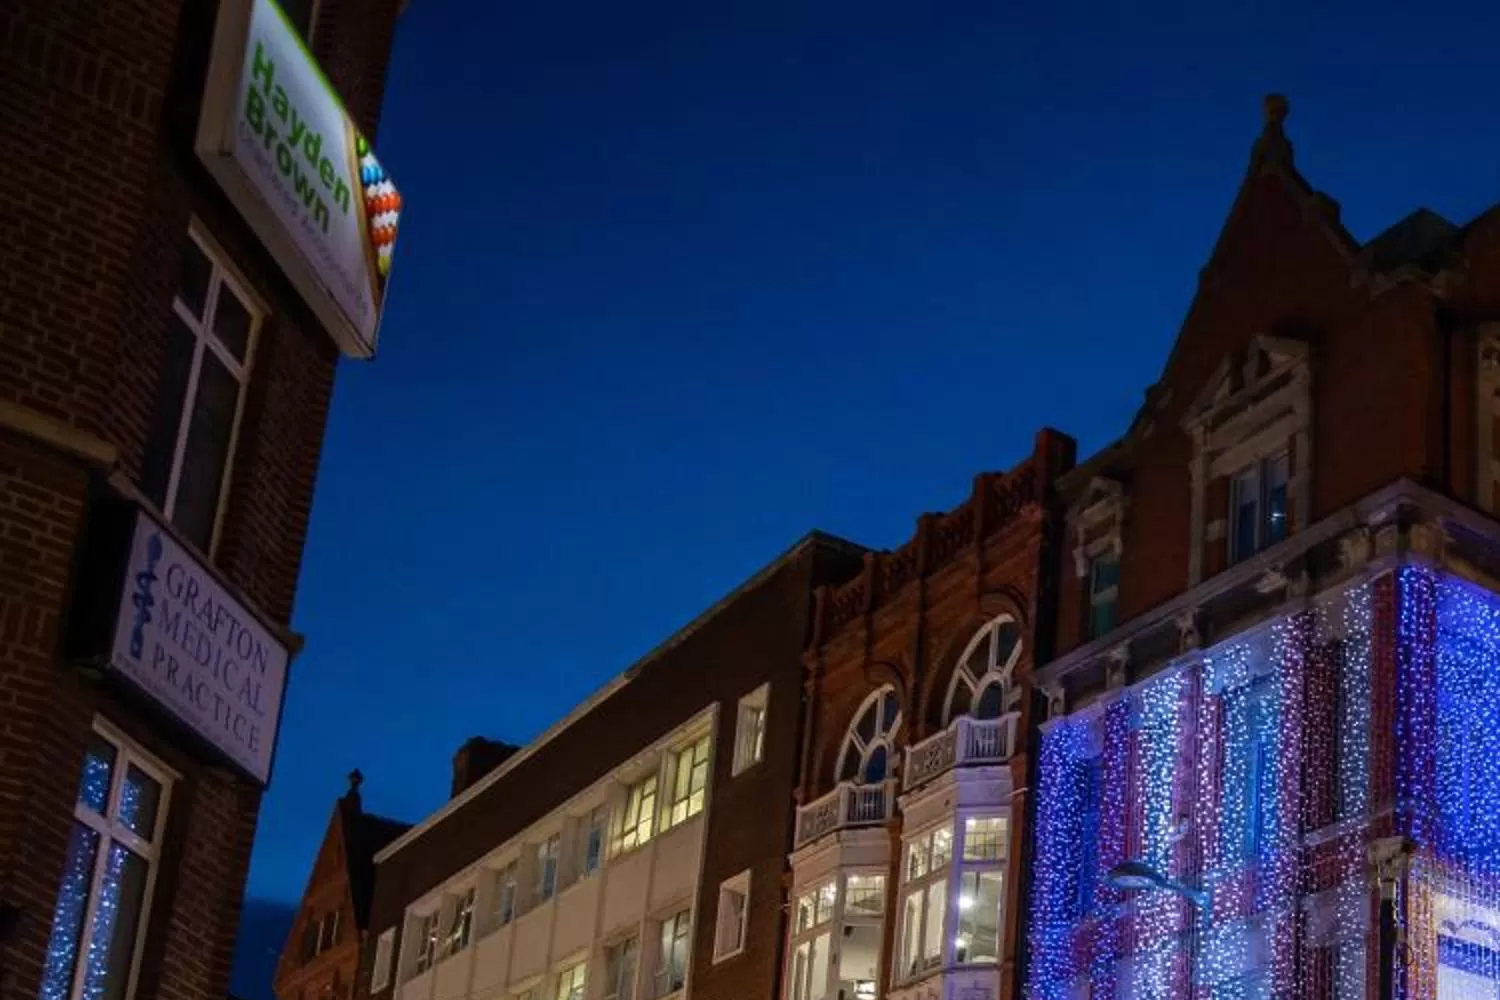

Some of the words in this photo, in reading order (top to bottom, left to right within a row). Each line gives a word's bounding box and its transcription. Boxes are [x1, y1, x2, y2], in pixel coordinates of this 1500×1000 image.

[246, 83, 330, 234] Brown
[252, 40, 350, 216] Hayden
[160, 598, 266, 716] MEDICAL
[166, 563, 268, 673] GRAFTON
[153, 642, 261, 753] PRACTICE
